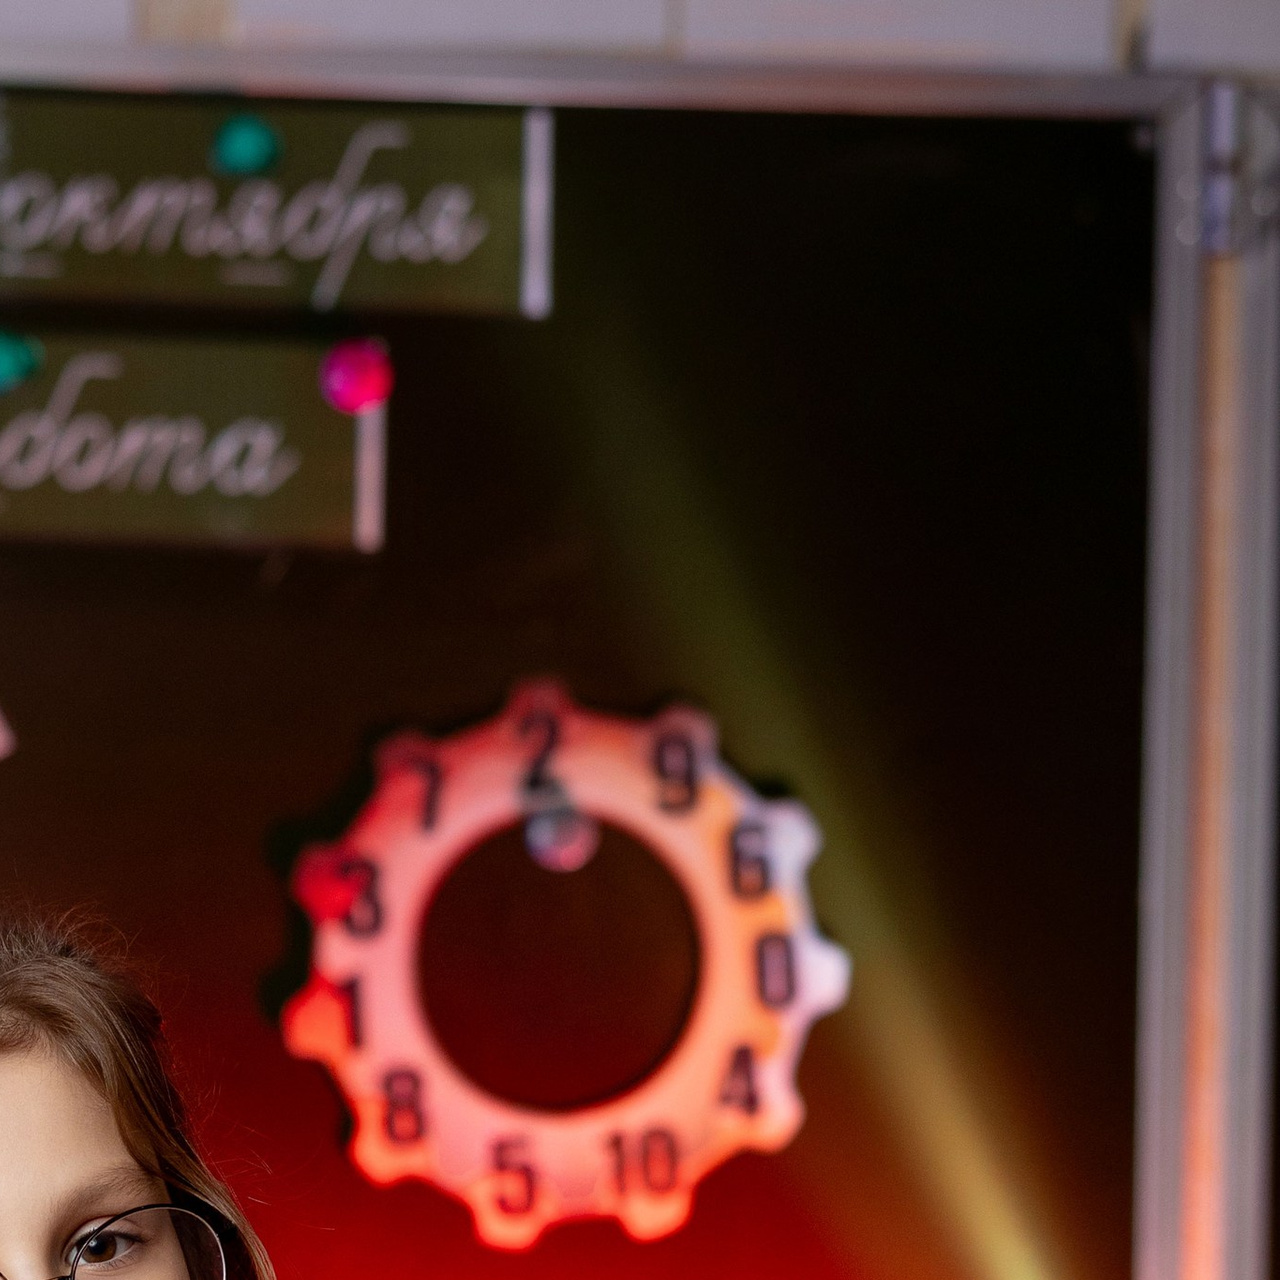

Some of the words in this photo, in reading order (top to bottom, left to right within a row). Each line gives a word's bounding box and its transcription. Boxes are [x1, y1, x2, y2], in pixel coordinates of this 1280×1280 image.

[656, 731, 697, 814] 9
[733, 820, 771, 896] 6
[342, 857, 381, 936] 3
[757, 932, 794, 1010] 0
[336, 973, 363, 1048] 1
[384, 1069, 425, 1144] 8
[720, 1045, 761, 1117] 4
[493, 1133, 536, 1214] 5
[608, 1127, 678, 1196] 10
